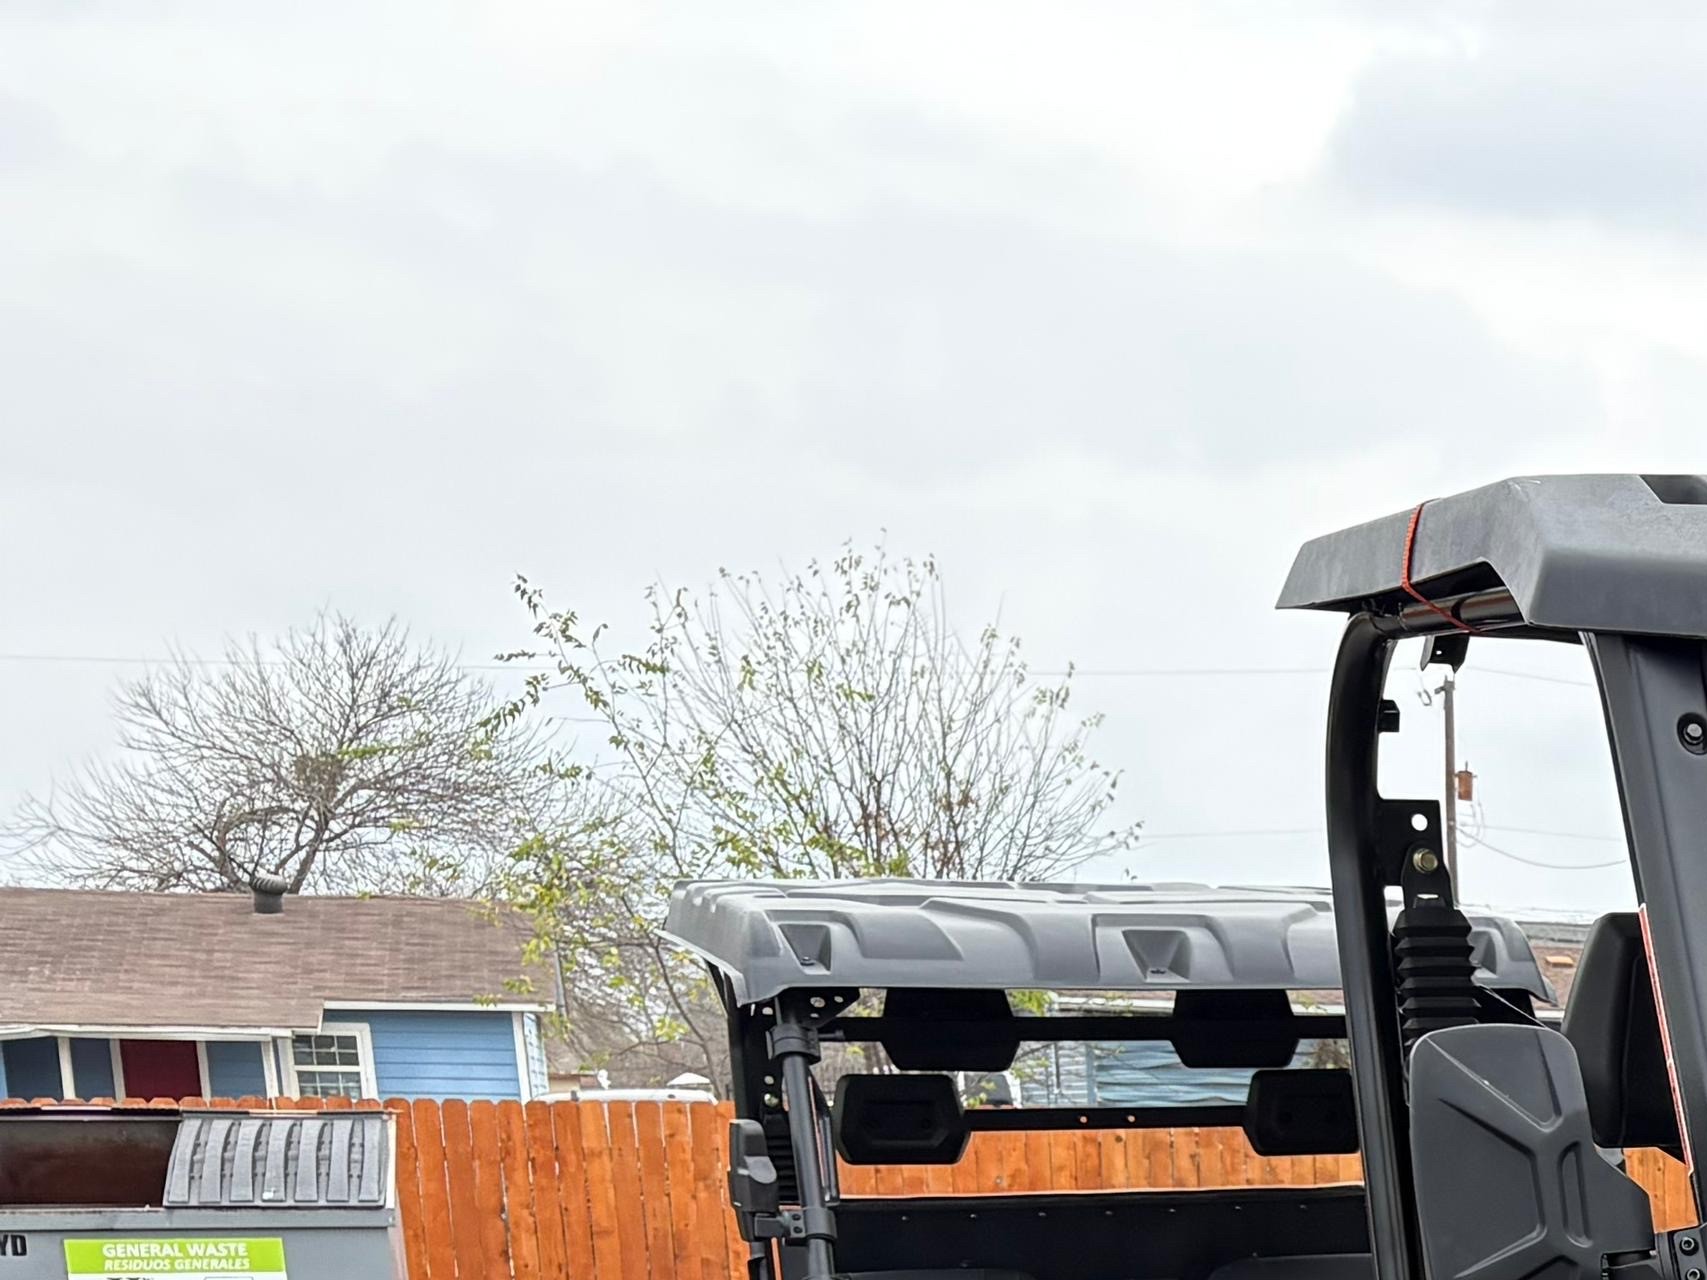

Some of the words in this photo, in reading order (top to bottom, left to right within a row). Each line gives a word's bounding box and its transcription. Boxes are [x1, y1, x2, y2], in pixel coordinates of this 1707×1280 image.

[102, 1243, 184, 1258] GENERAL
[187, 1242, 247, 1257] WASTE
[104, 1260, 170, 1271] RESIDUOS
[174, 1258, 250, 1270] GENERALES
